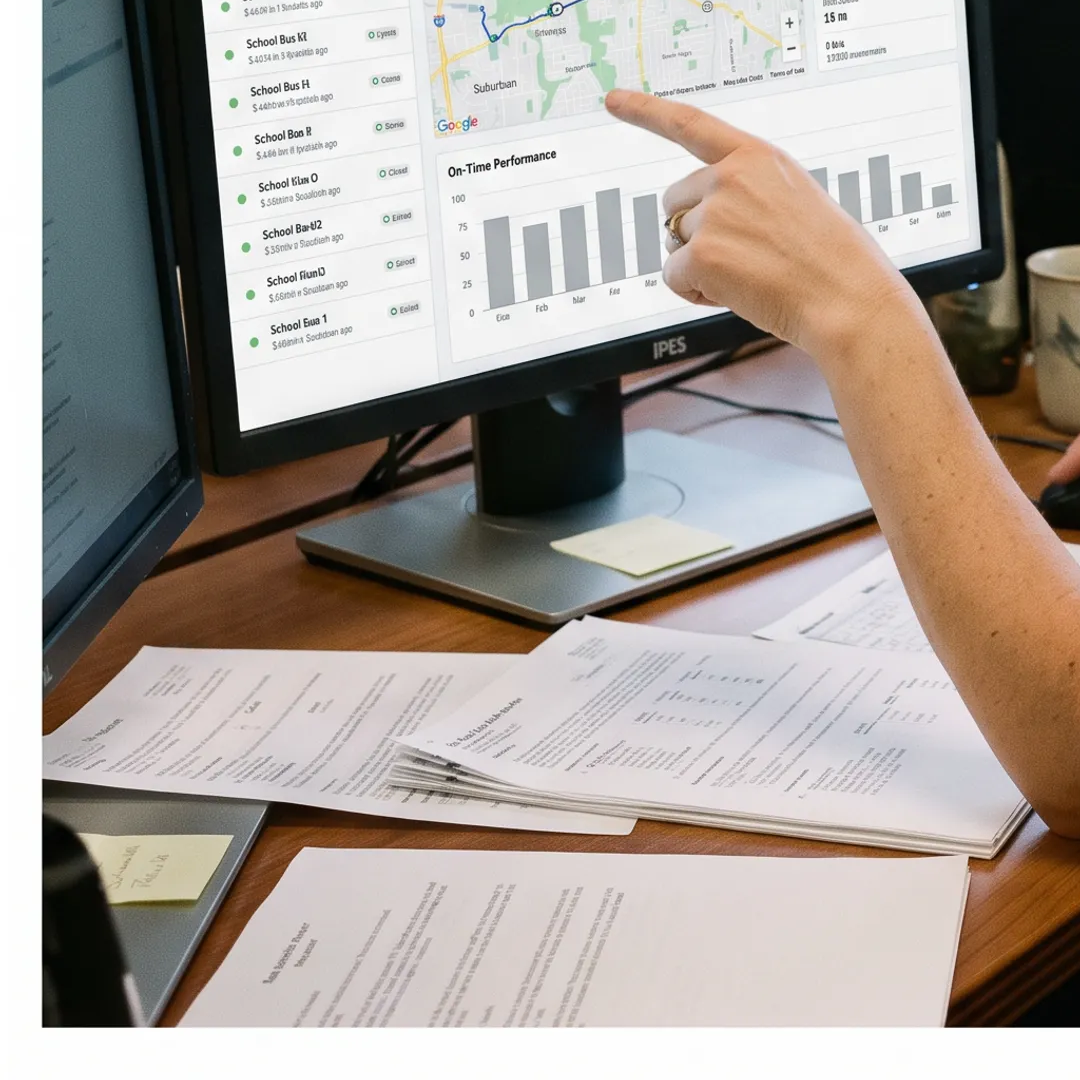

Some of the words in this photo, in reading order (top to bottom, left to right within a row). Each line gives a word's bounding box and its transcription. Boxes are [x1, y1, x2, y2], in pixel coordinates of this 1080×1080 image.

[310, 0, 323, 10] ago
[246, 34, 278, 49] School
[280, 34, 296, 45] Bus
[315, 47, 328, 56] ago
[250, 82, 281, 97] School
[283, 81, 300, 92] Bus
[320, 93, 334, 103] ago
[437, 115, 478, 132] Google
[254, 130, 286, 145] School
[324, 141, 338, 150] ago
[448, 162, 491, 178] On-Time
[493, 149, 557, 170] Performance
[258, 177, 290, 192] School
[328, 186, 341, 197] ago
[451, 194, 466, 204] 100
[262, 225, 294, 240] School
[457, 223, 468, 232] 75
[331, 233, 344, 243] ago
[460, 251, 470, 261] 50
[266, 273, 298, 287] School
[336, 279, 349, 290] ago
[462, 280, 473, 289] 25
[469, 309, 475, 318] 0
[270, 320, 301, 335] School
[340, 326, 353, 336] ago
[653, 335, 687, 360] IPES
